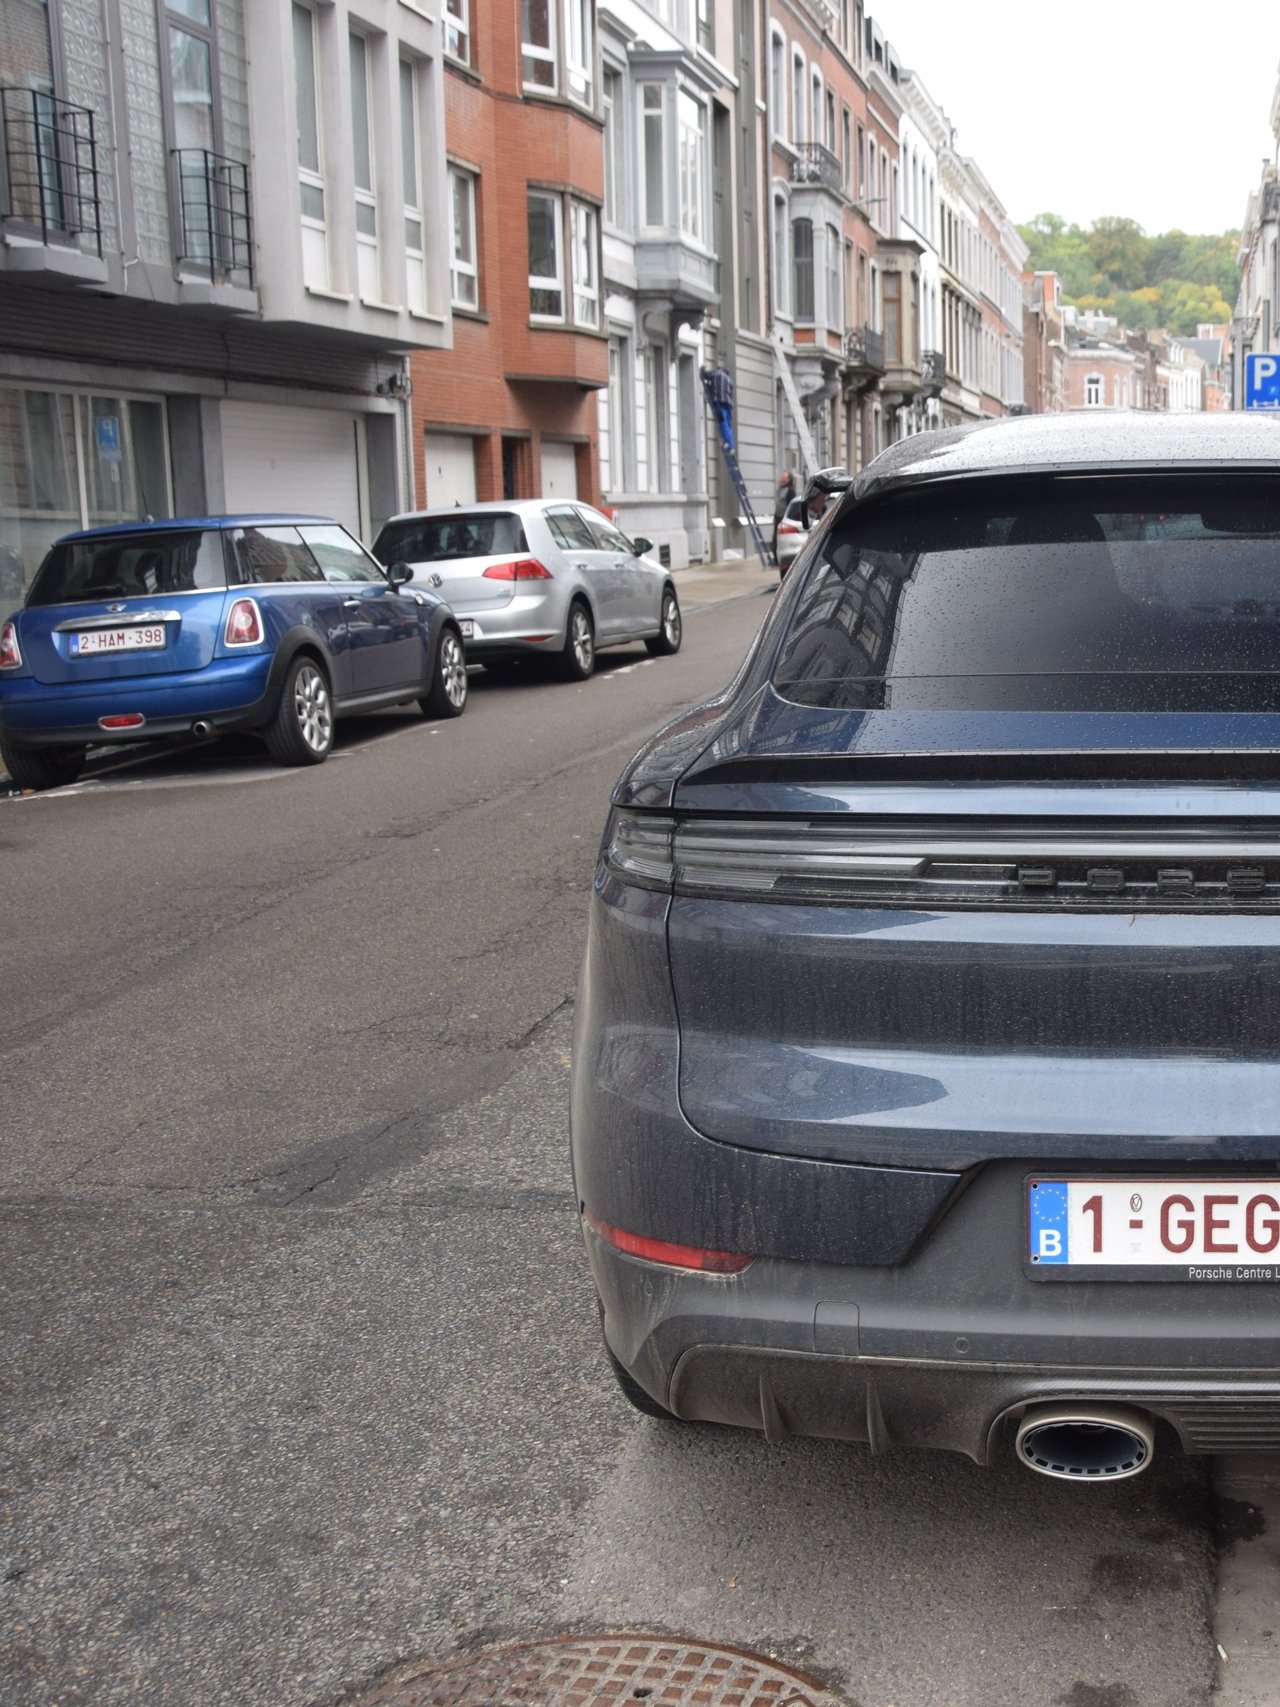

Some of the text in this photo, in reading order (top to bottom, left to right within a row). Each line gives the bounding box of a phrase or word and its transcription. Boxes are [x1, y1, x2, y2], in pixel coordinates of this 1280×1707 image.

[1254, 357, 1277, 391] P
[1039, 1229, 1063, 1257] B
[1188, 1266, 1233, 1279] Porsche
[1236, 1266, 1272, 1279] Centre
